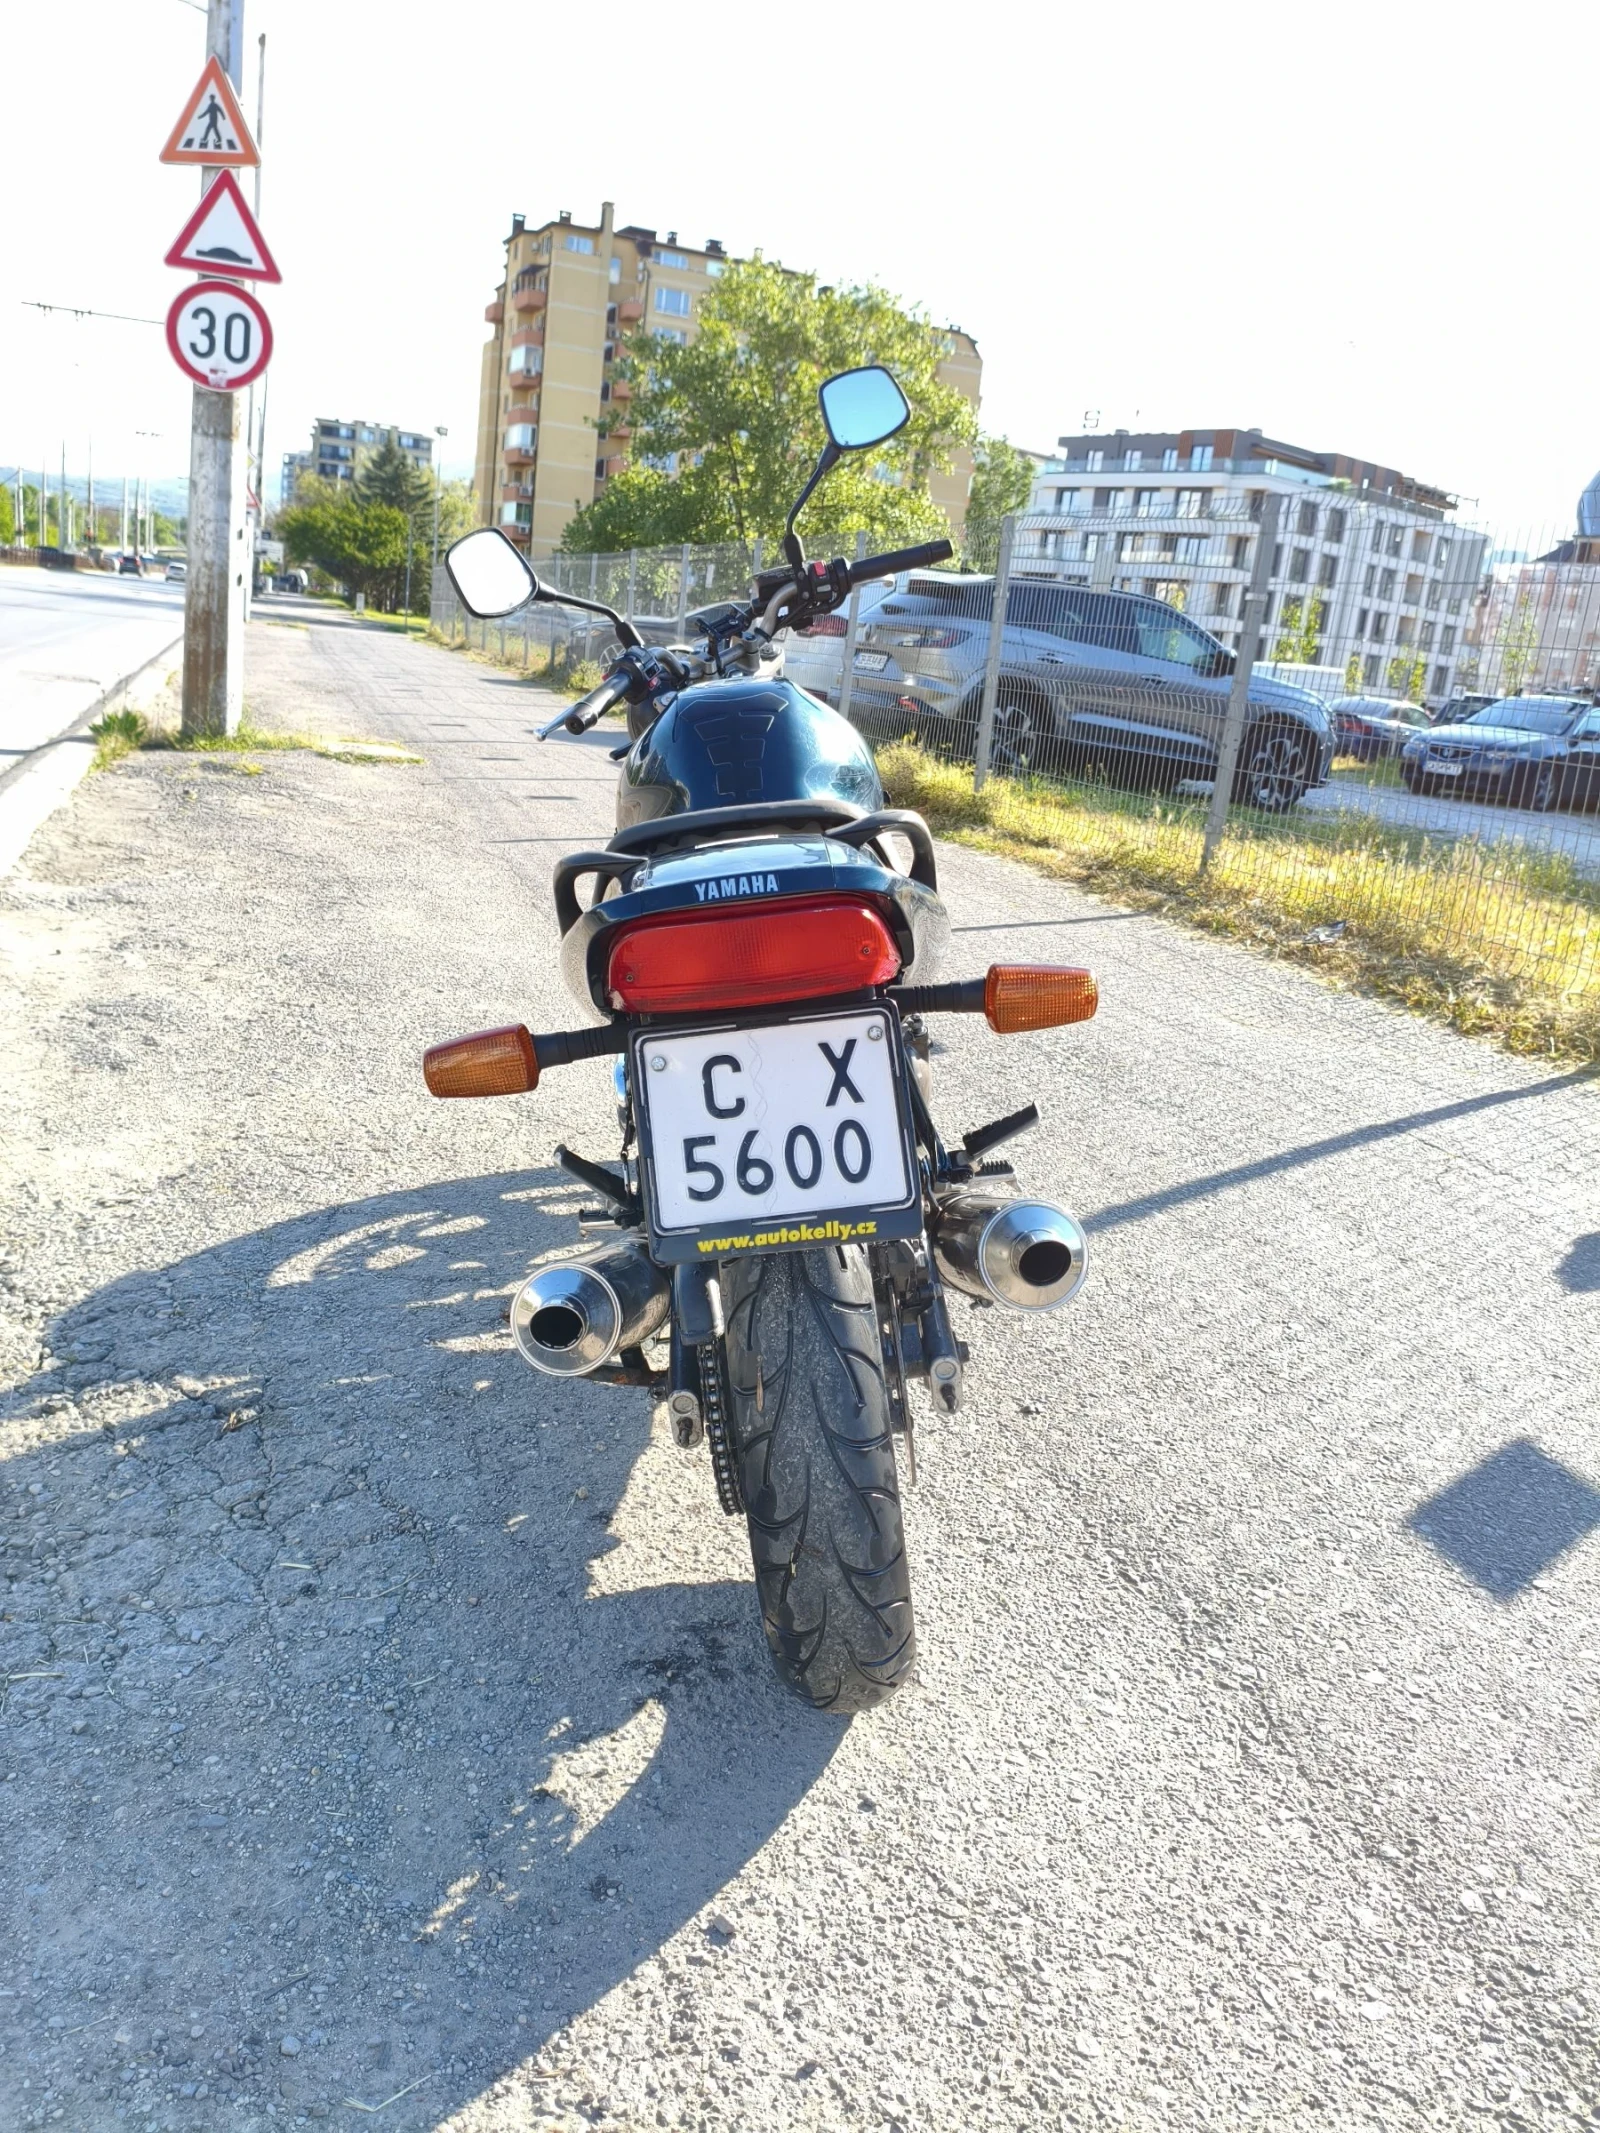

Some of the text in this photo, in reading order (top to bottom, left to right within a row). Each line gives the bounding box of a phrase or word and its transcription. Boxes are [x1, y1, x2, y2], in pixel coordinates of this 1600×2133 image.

[189, 306, 251, 365] 30
[694, 874, 779, 902] YAMAHA
[702, 1039, 865, 1120] C X
[682, 1119, 872, 1202] 5600
[697, 1220, 877, 1253] www.autokelly.cz
